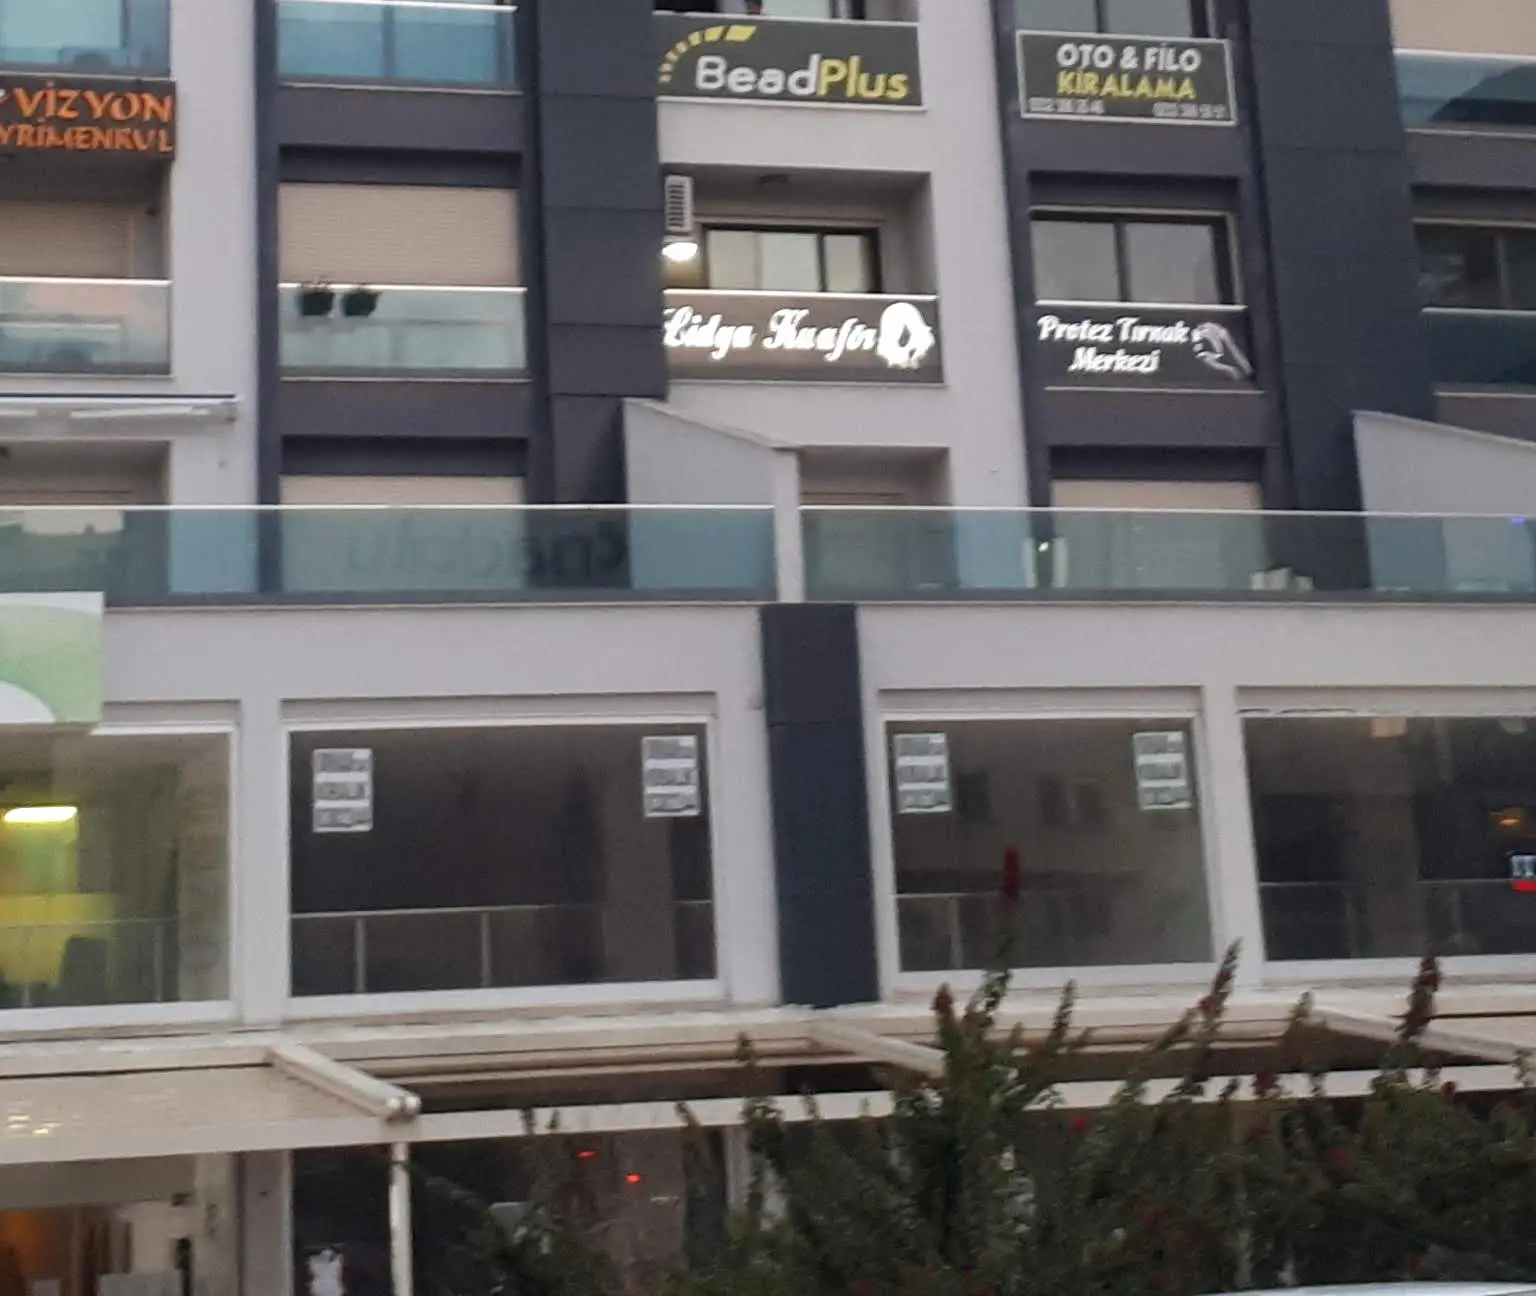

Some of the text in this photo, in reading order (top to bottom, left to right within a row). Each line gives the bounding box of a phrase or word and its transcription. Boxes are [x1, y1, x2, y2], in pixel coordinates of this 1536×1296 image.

[1056, 42, 1114, 69] OTO
[1120, 45, 1139, 70] &
[695, 54, 909, 98] BeadPlus
[13, 80, 173, 122] VİZYON
[1036, 314, 1114, 342] Protez
